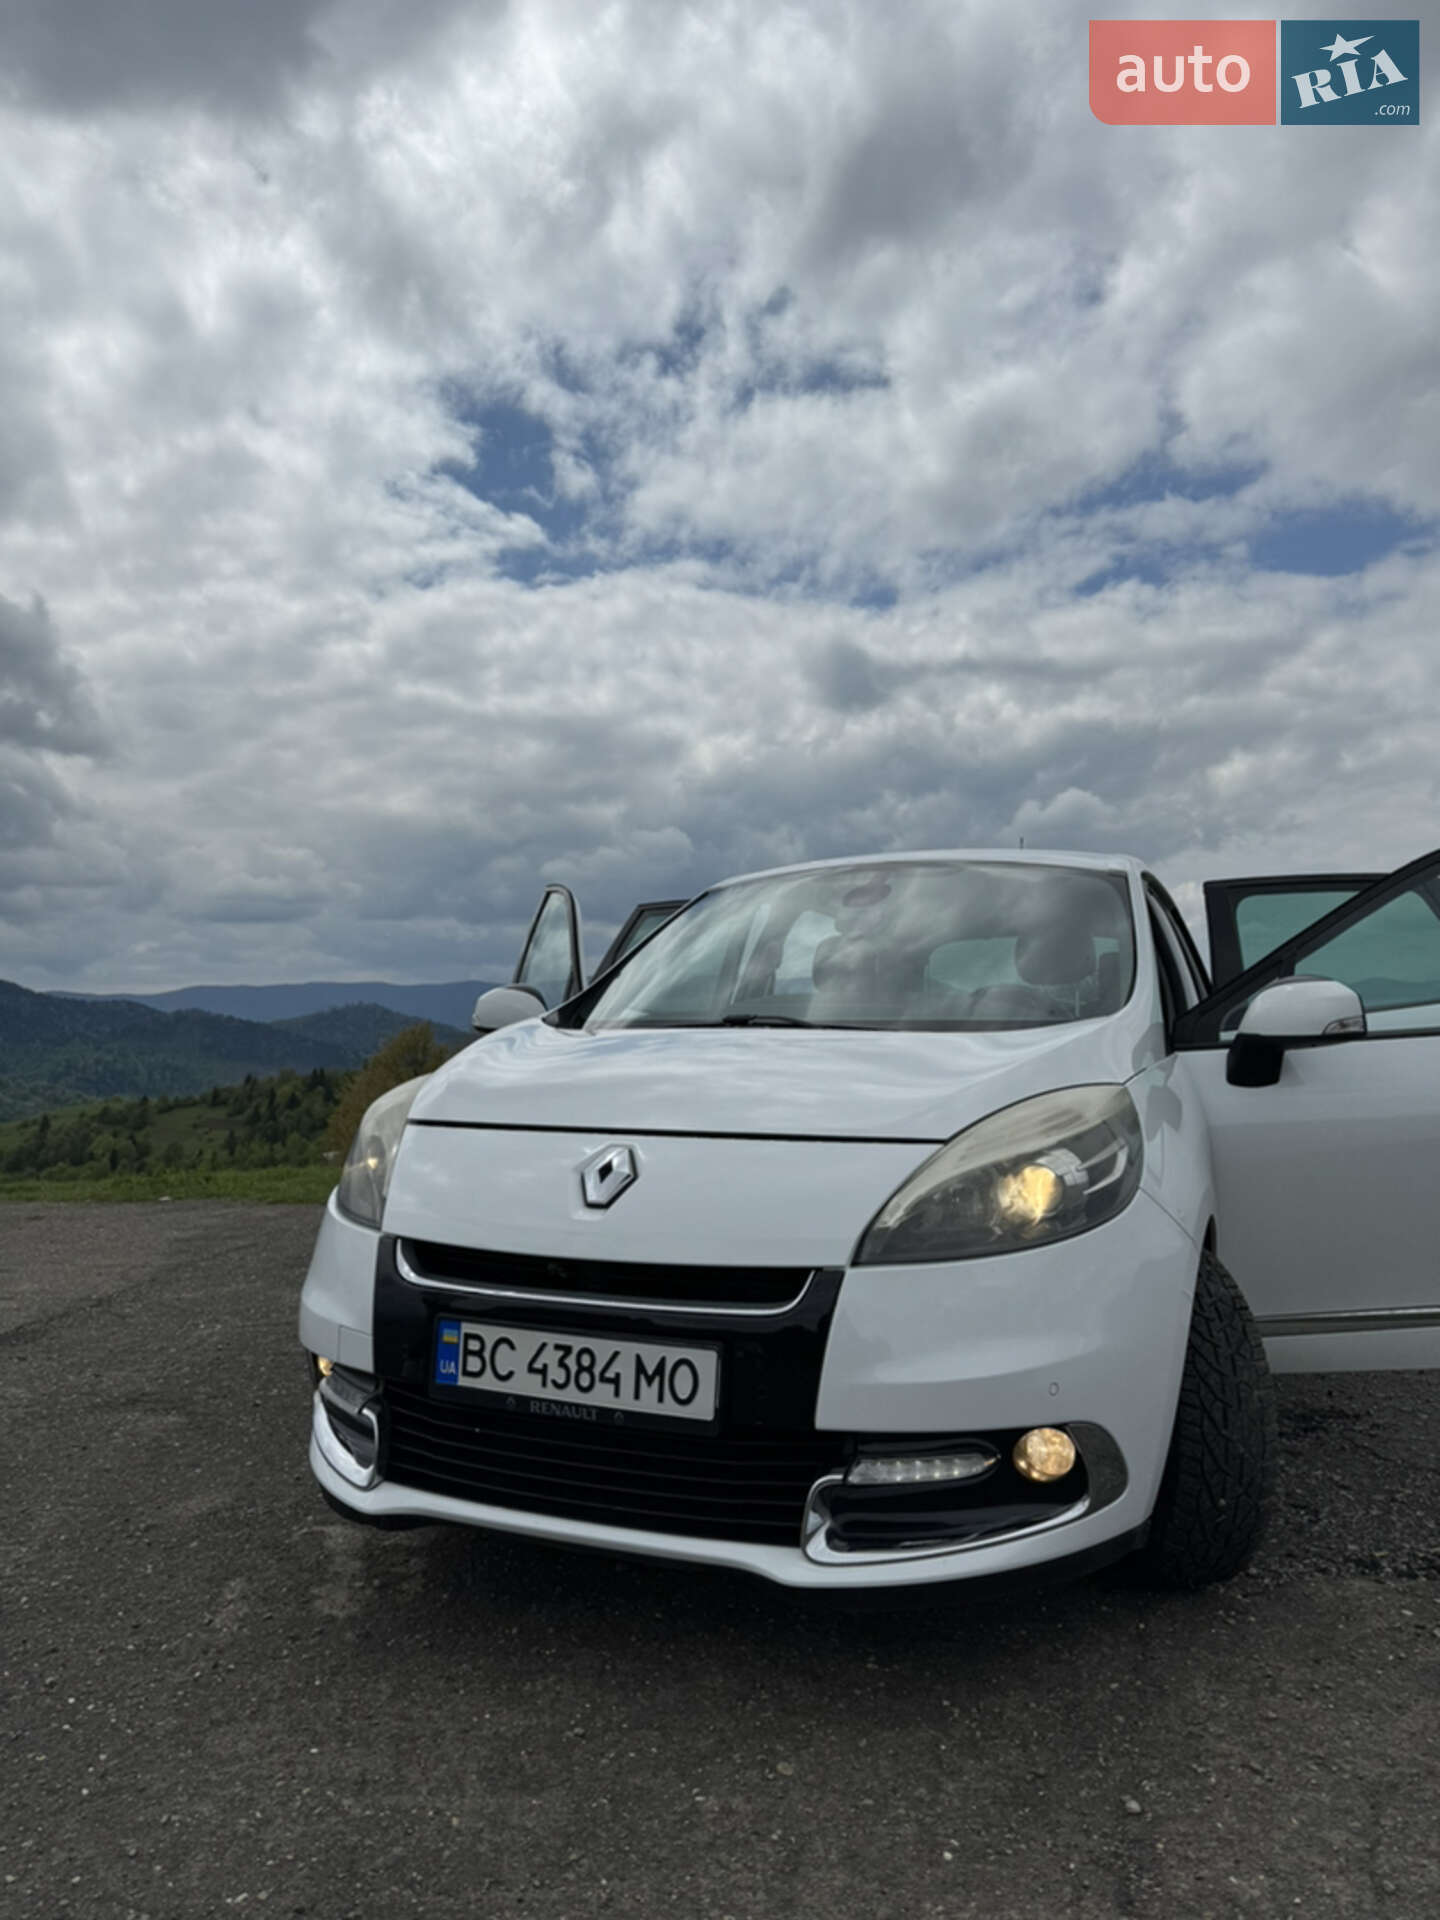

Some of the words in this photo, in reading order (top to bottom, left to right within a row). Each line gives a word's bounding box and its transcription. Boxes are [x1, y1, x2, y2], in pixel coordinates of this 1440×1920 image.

[440, 1360, 456, 1375] UA
[461, 1332, 516, 1382] BC
[527, 1342, 622, 1398] 4384
[633, 1353, 699, 1406] MO
[530, 1401, 598, 1421] RENAULT
